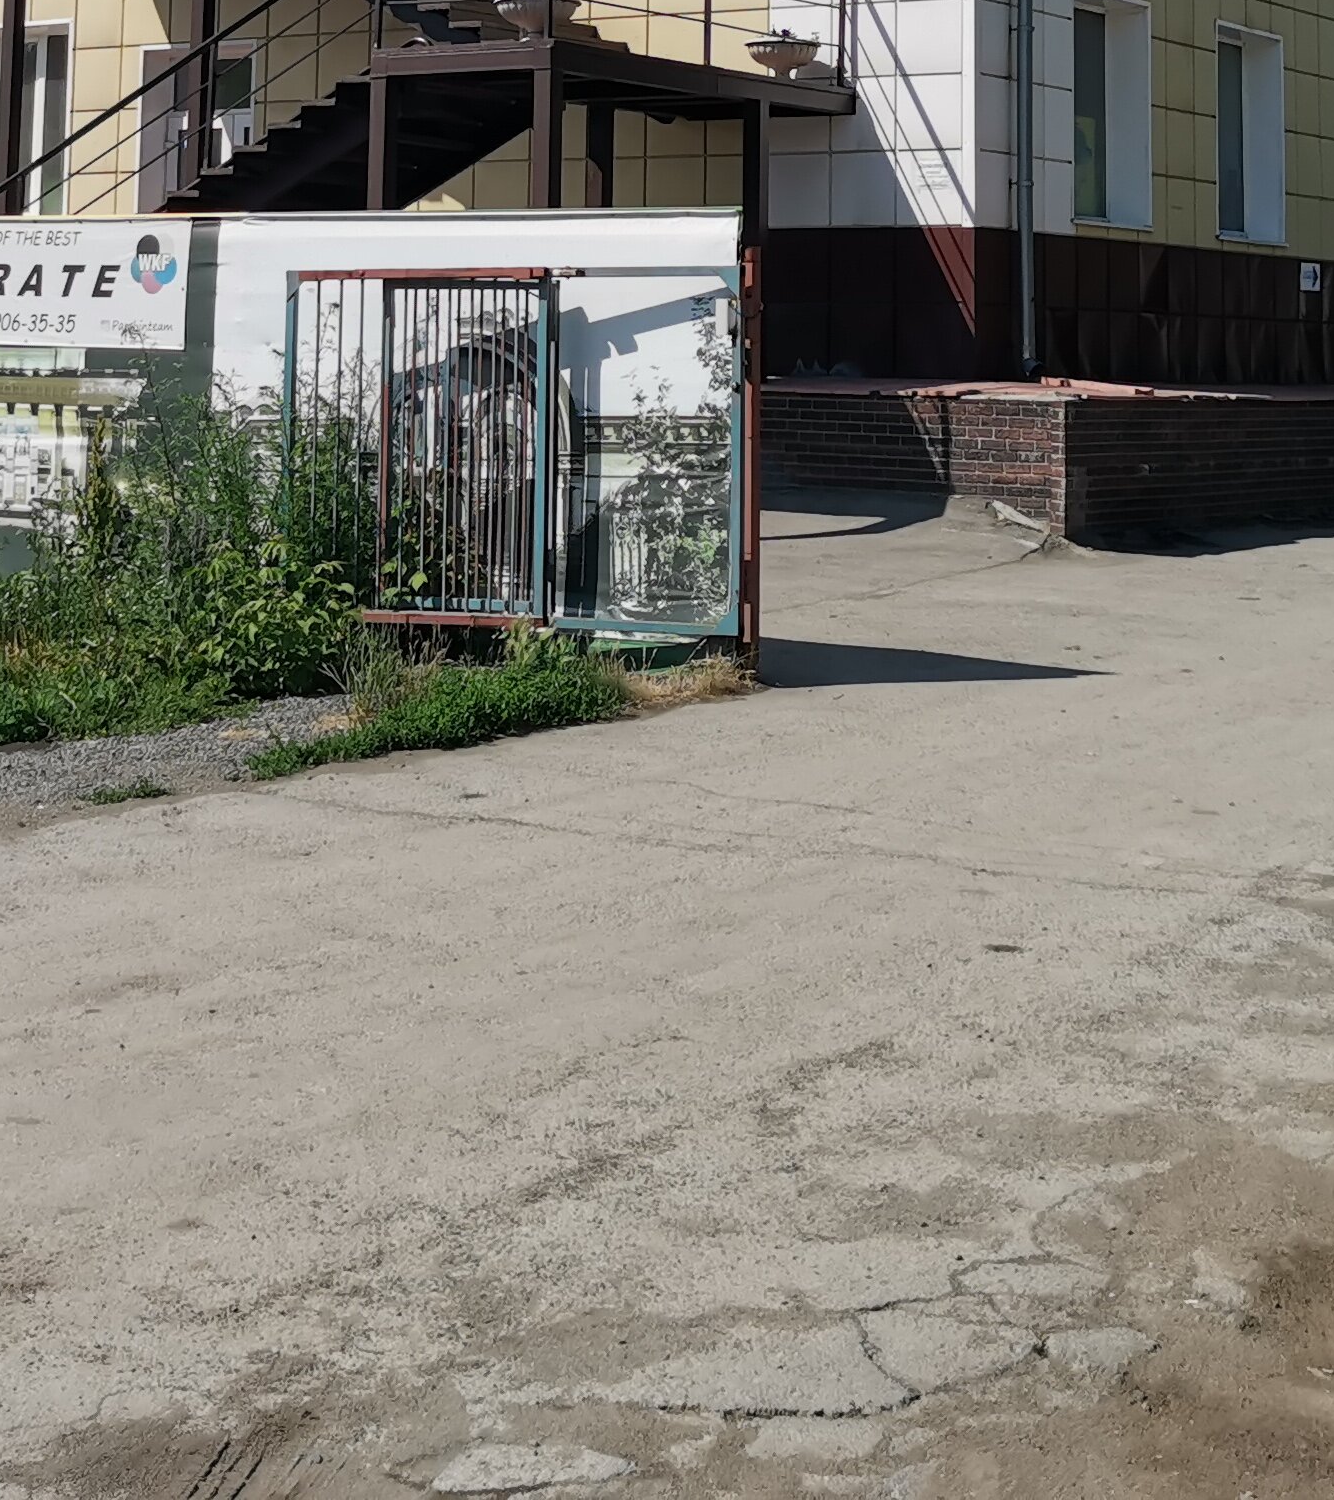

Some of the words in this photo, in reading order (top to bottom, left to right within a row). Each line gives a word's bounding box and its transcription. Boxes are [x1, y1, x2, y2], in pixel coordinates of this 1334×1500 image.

[16, 231, 43, 246] THE
[45, 231, 82, 246] BEST
[138, 253, 172, 272] WKF
